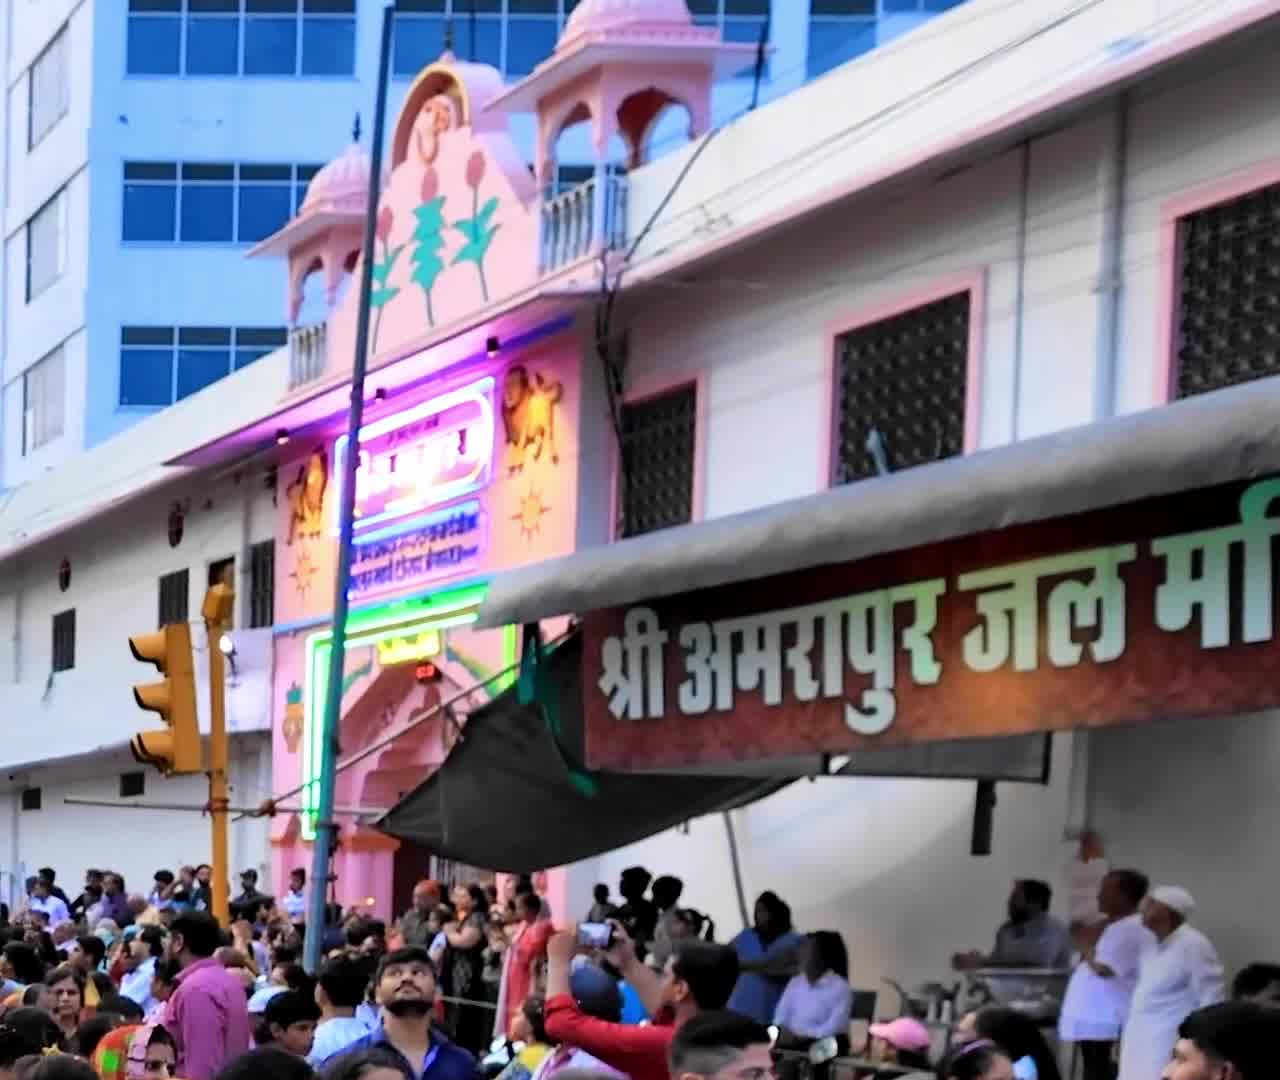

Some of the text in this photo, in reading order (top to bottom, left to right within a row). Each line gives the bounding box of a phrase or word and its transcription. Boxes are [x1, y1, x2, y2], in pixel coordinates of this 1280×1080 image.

[599, 608, 668, 721] श्री
[677, 577, 946, 735] अमरापुर
[958, 543, 1137, 673] जल
